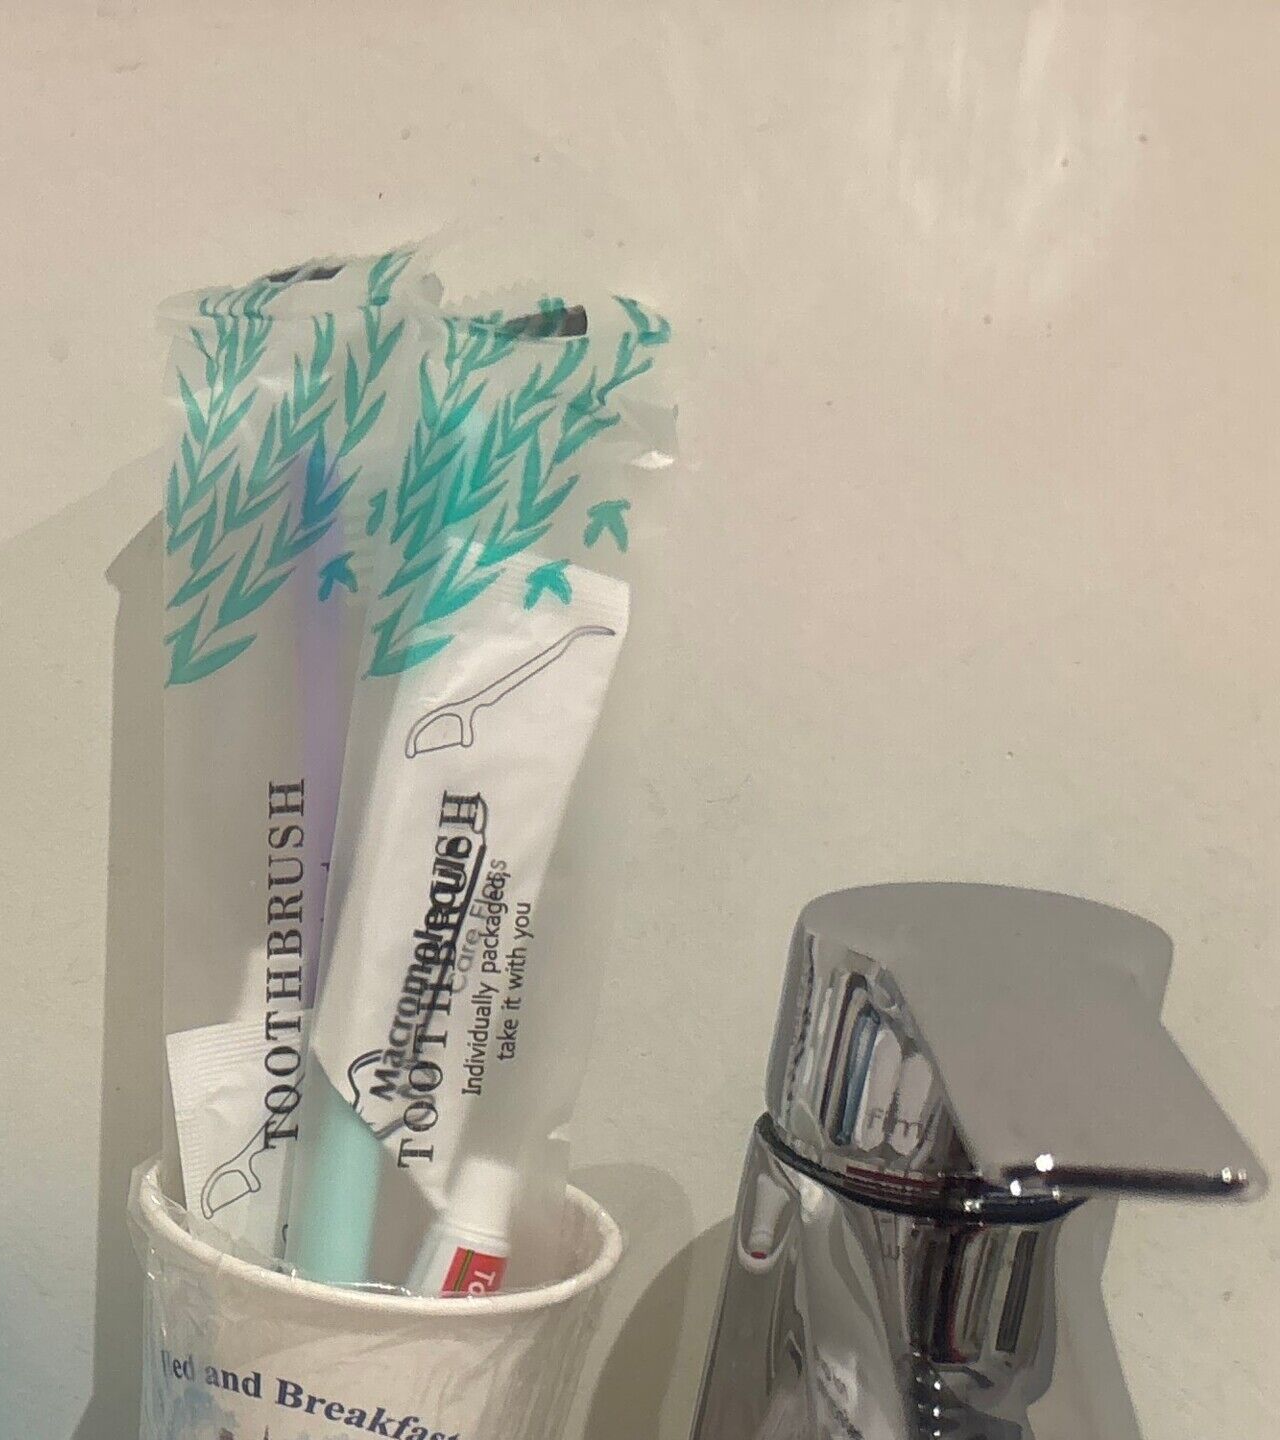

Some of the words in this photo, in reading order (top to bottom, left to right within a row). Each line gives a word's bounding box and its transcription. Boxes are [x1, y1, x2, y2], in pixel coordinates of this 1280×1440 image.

[514, 902, 533, 940] you
[264, 778, 305, 1150] TOOTHBRUSH
[397, 789, 481, 1169] TOOTHBRUSH
[449, 928, 482, 994] Care
[505, 948, 527, 991] with
[501, 997, 521, 1013] it
[461, 981, 499, 1096] Individually
[497, 1018, 519, 1061] take
[204, 1365, 262, 1399] and
